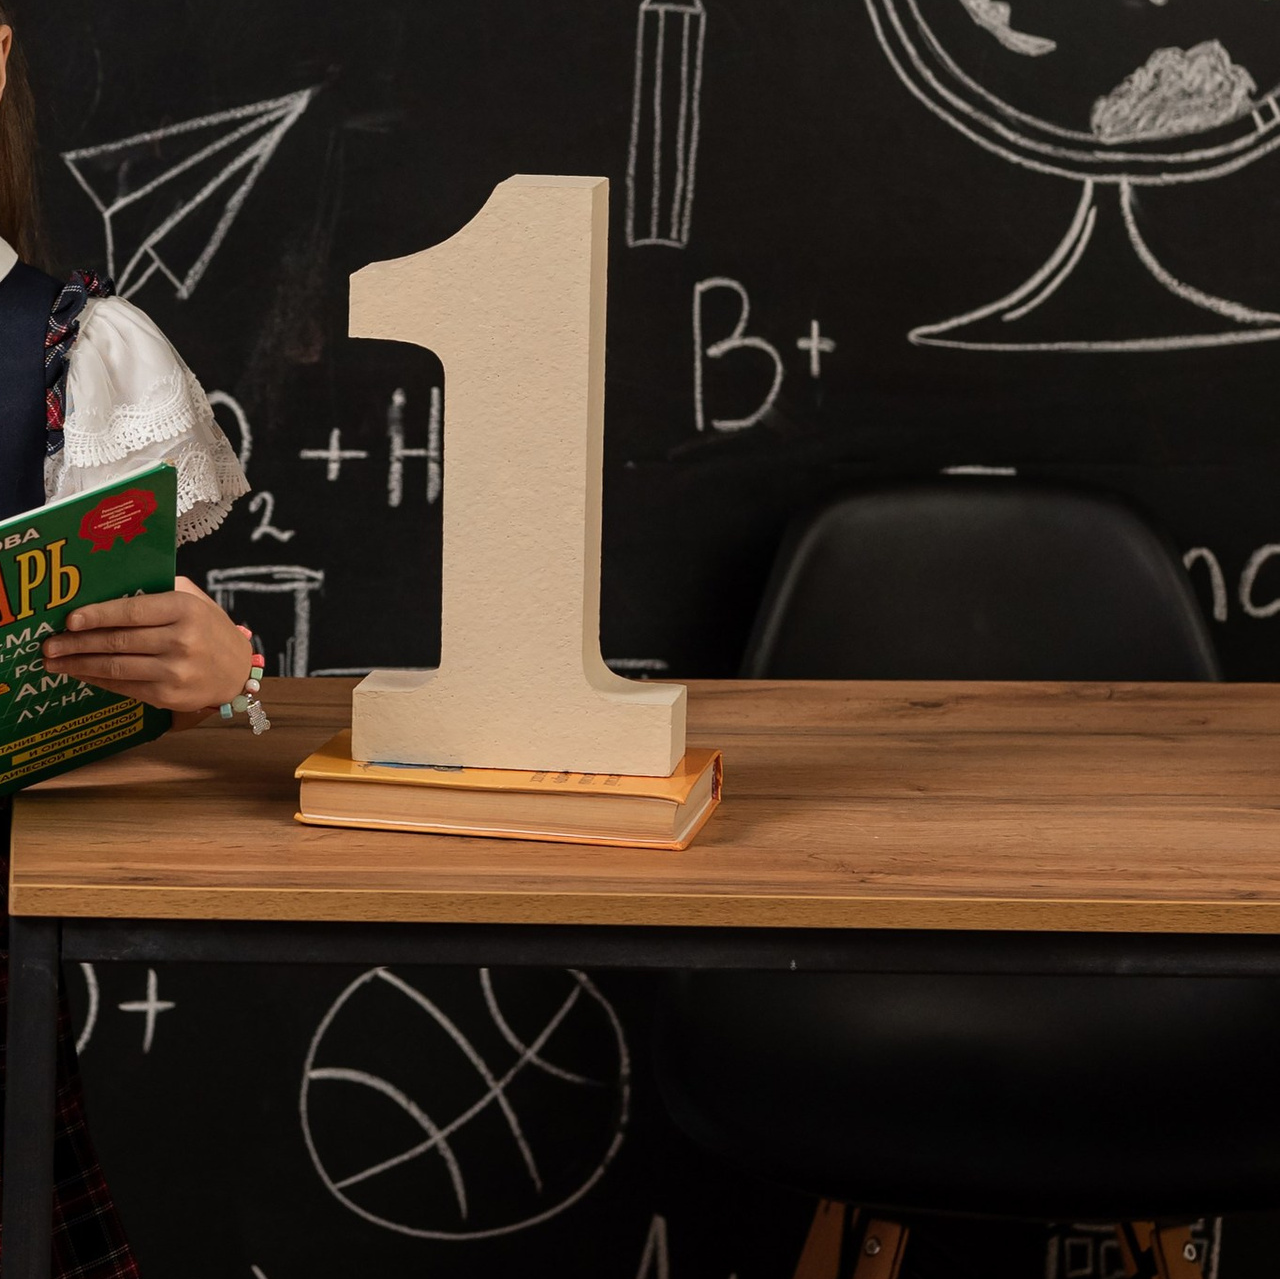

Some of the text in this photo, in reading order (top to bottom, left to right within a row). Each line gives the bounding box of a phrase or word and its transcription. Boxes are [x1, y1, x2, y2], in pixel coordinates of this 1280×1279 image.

[39, 698, 138, 740] ТРАДИЦИОННОЙ
[39, 710, 138, 753] ОРИГИНАЛЬНОЙ
[71, 725, 138, 756] МЕТОДИКИ
